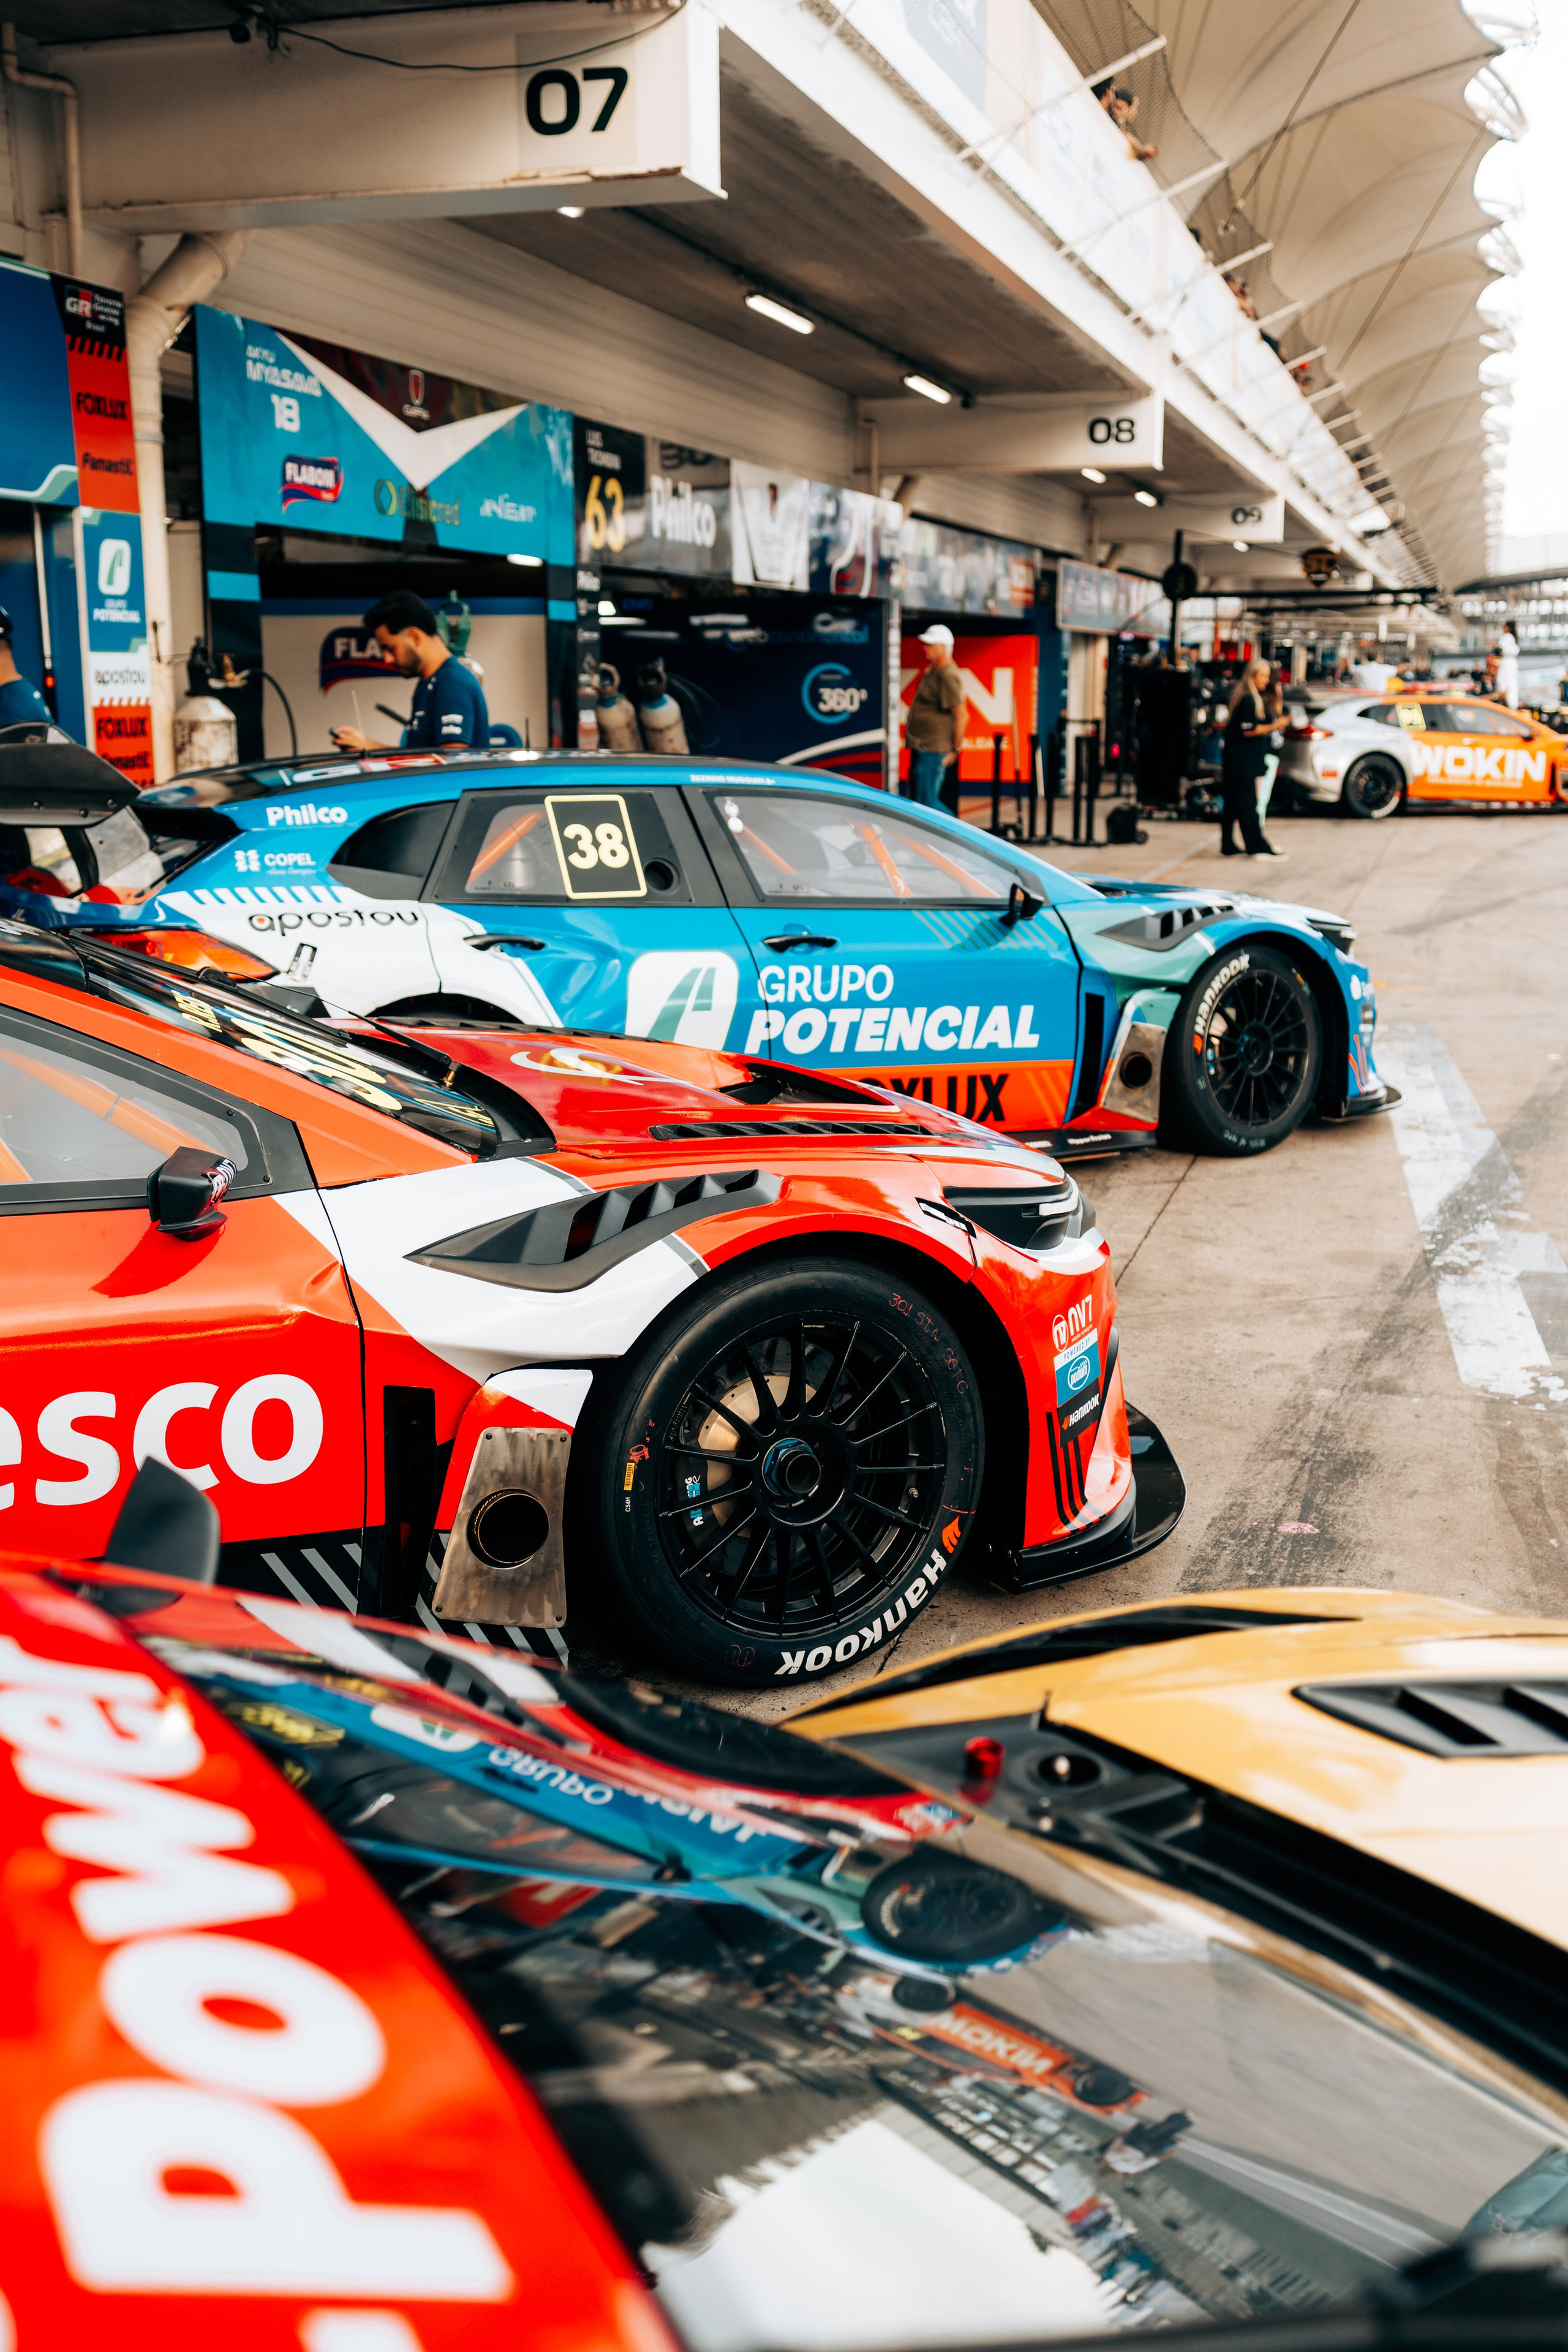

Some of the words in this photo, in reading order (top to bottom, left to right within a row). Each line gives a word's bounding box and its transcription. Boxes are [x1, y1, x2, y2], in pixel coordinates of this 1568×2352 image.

[526, 66, 628, 136] 07
[66, 296, 92, 317] GR
[76, 391, 129, 420] FOXLUX
[270, 394, 300, 432] 18
[1090, 418, 1135, 443] 08
[585, 475, 625, 552] 63
[650, 474, 717, 548] Philco
[1232, 507, 1262, 524] 09
[334, 638, 386, 660] FLA
[97, 716, 148, 738] FOXLUX
[1409, 744, 1547, 782] WOKIN
[266, 803, 348, 826] Philco
[563, 823, 630, 869] 38
[264, 853, 317, 867] COPEL
[248, 909, 418, 937] apostou
[758, 964, 894, 1002] GRUPO
[744, 1005, 1040, 1054] POTENCIAL
[889, 1292, 914, 1317] 301
[1064, 1341, 1084, 1359] POWERED
[1085, 1336, 1090, 1346] BY
[1071, 1363, 1088, 1387] podium
